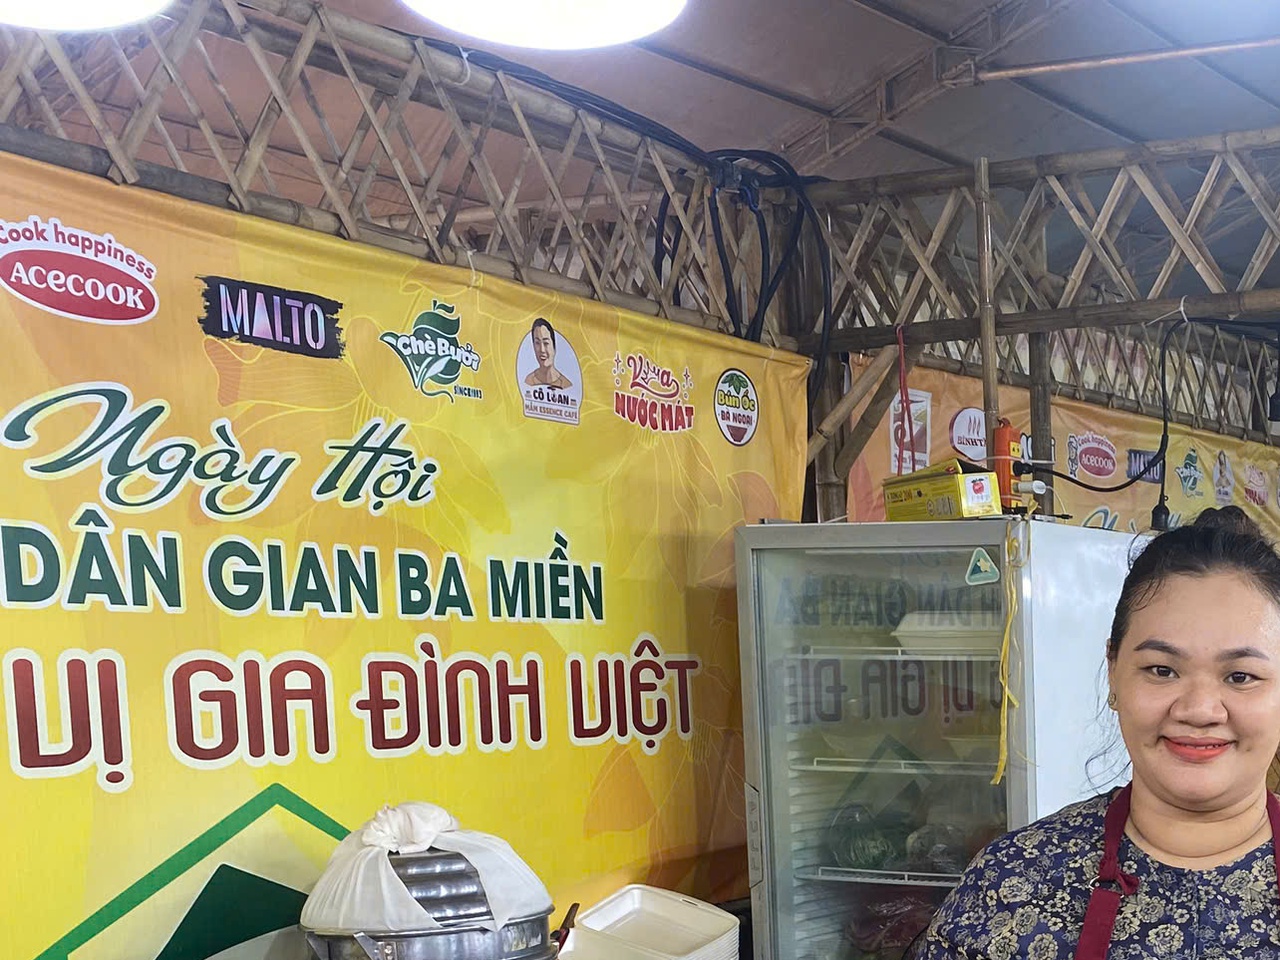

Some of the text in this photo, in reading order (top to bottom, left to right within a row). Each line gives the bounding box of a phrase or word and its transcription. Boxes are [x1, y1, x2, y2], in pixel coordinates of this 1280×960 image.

[54, 223, 154, 280] happiness
[219, 283, 327, 350] MALTO
[397, 334, 436, 356] Chè
[615, 392, 694, 431] NƯỚC MÁT
[718, 389, 756, 411] Bún Ốc
[3, 388, 438, 512] Ngày Hội
[1, 509, 604, 621] DÂN GIAN BA MIỀN
[173, 659, 332, 762] GIA
[356, 640, 544, 752] ĐÌNH
